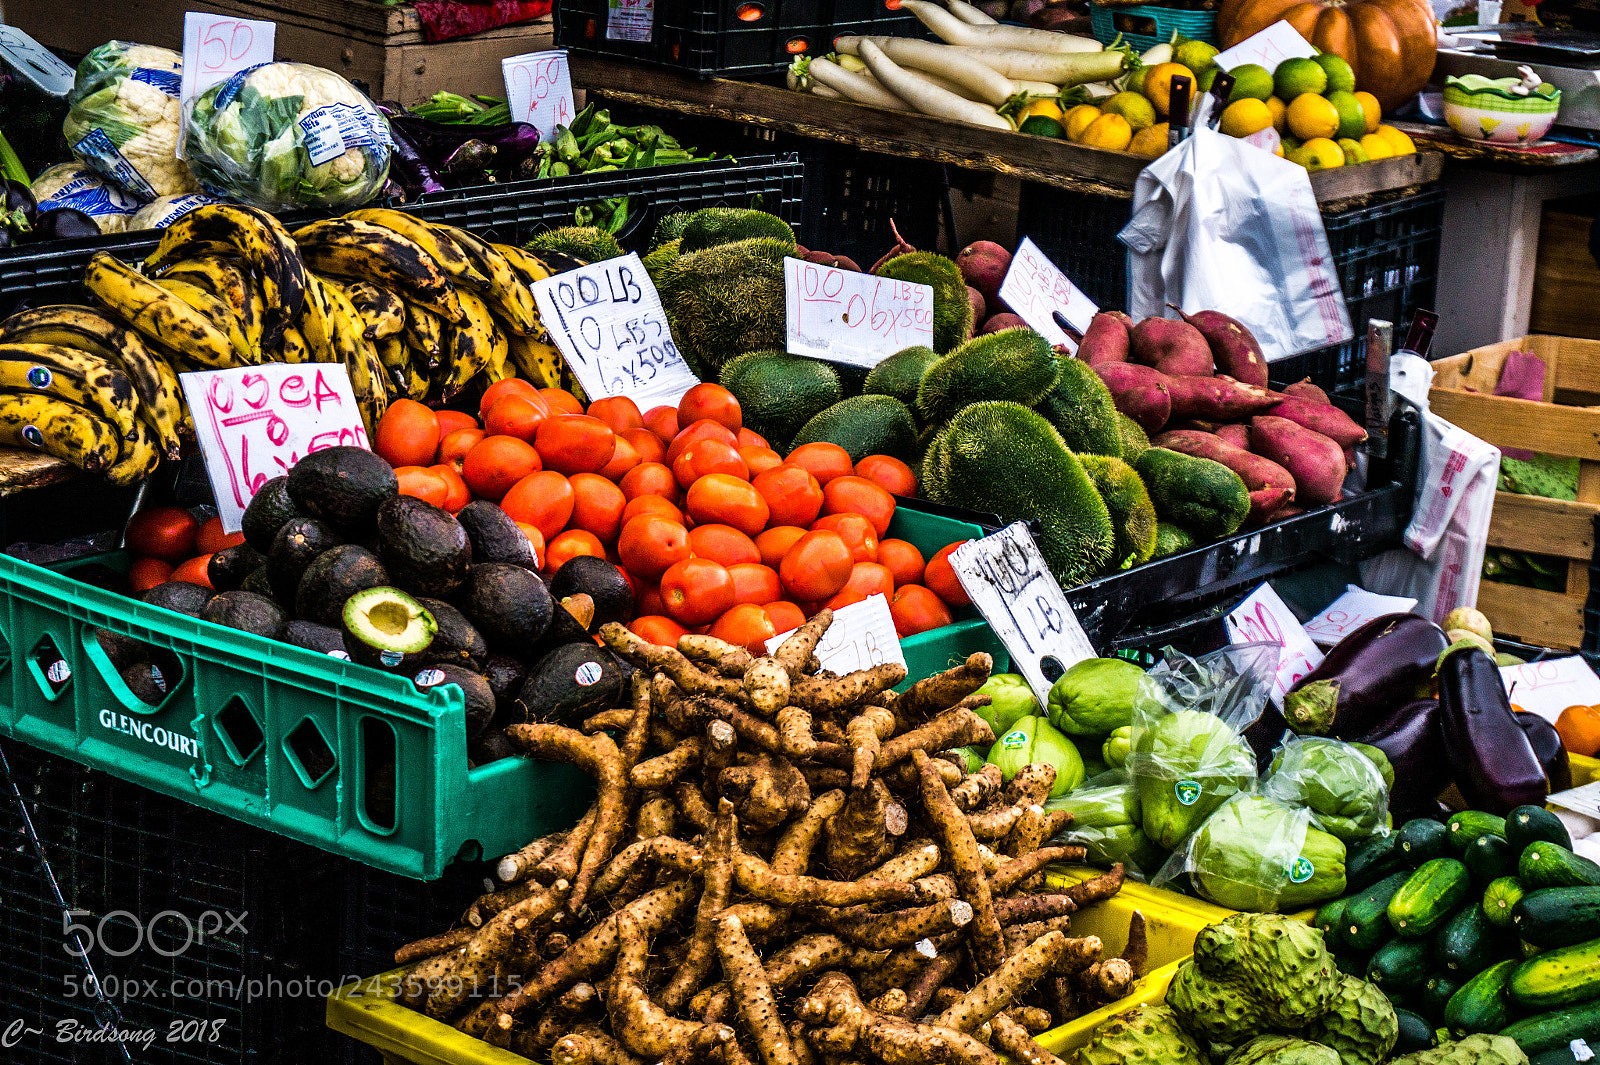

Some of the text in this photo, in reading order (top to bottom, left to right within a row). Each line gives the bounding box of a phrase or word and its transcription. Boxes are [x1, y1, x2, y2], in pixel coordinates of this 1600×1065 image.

[605, 266, 642, 304] LB
[893, 281, 925, 304] LBS
[611, 313, 662, 351] LBS
[1027, 595, 1063, 641] LB
[99, 709, 199, 758] GLENCOURT
